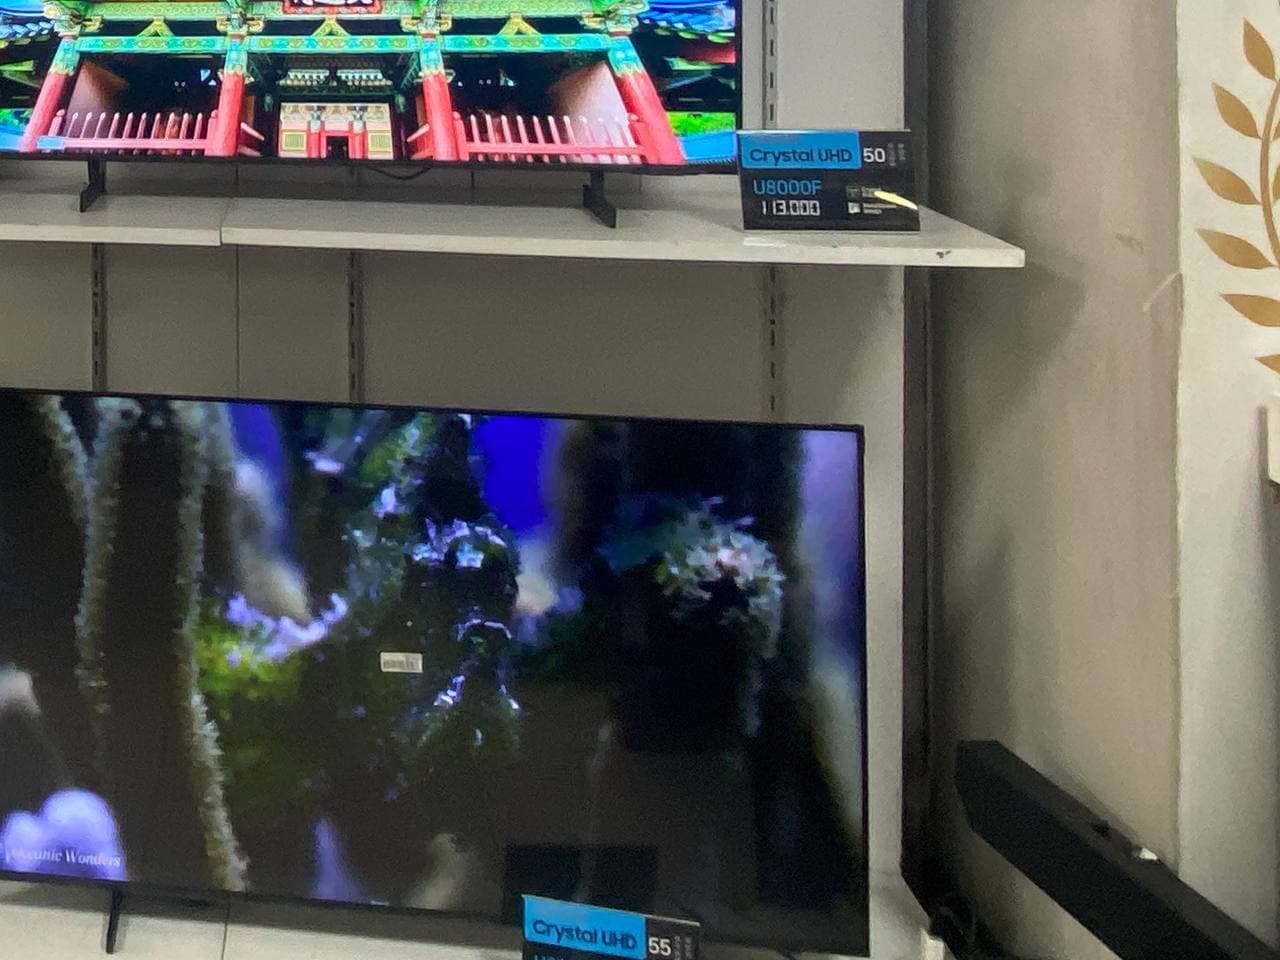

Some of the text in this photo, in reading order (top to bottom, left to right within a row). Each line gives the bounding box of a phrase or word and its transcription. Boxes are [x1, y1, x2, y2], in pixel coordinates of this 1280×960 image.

[750, 148, 814, 166] Crystal
[818, 149, 853, 163] UHD
[864, 148, 886, 163] 50
[753, 179, 823, 196] U8000F
[65, 849, 121, 868] Wonders
[532, 919, 598, 944] Crystal
[601, 929, 638, 949] UHD
[648, 936, 672, 956] 55
